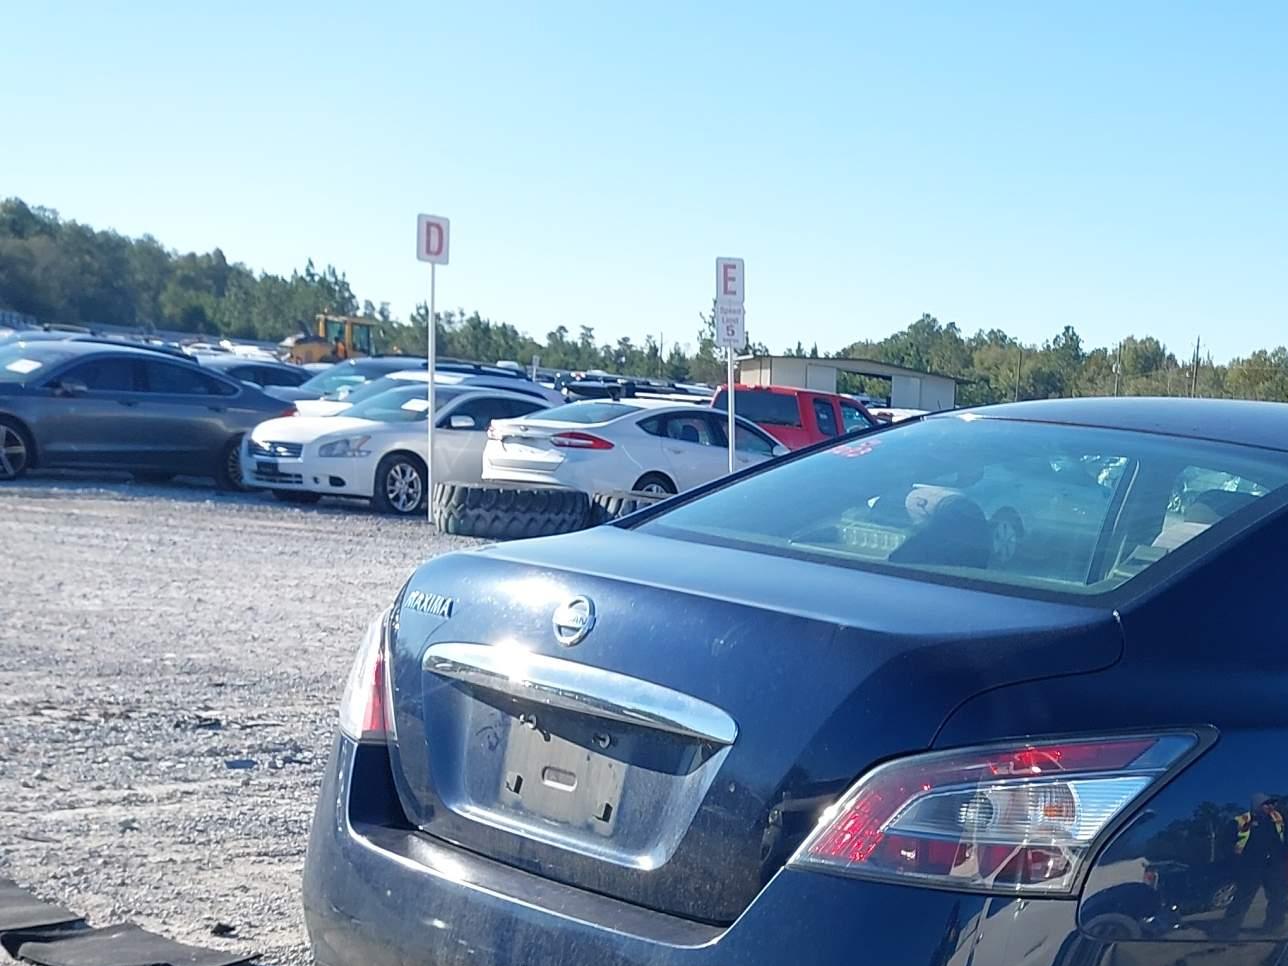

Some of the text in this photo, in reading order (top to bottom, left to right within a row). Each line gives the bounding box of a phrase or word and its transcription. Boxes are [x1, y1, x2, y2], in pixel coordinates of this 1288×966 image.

[425, 220, 443, 256] D
[723, 263, 737, 295] E
[726, 325, 735, 337] 5
[404, 590, 453, 618] MAXIMA
